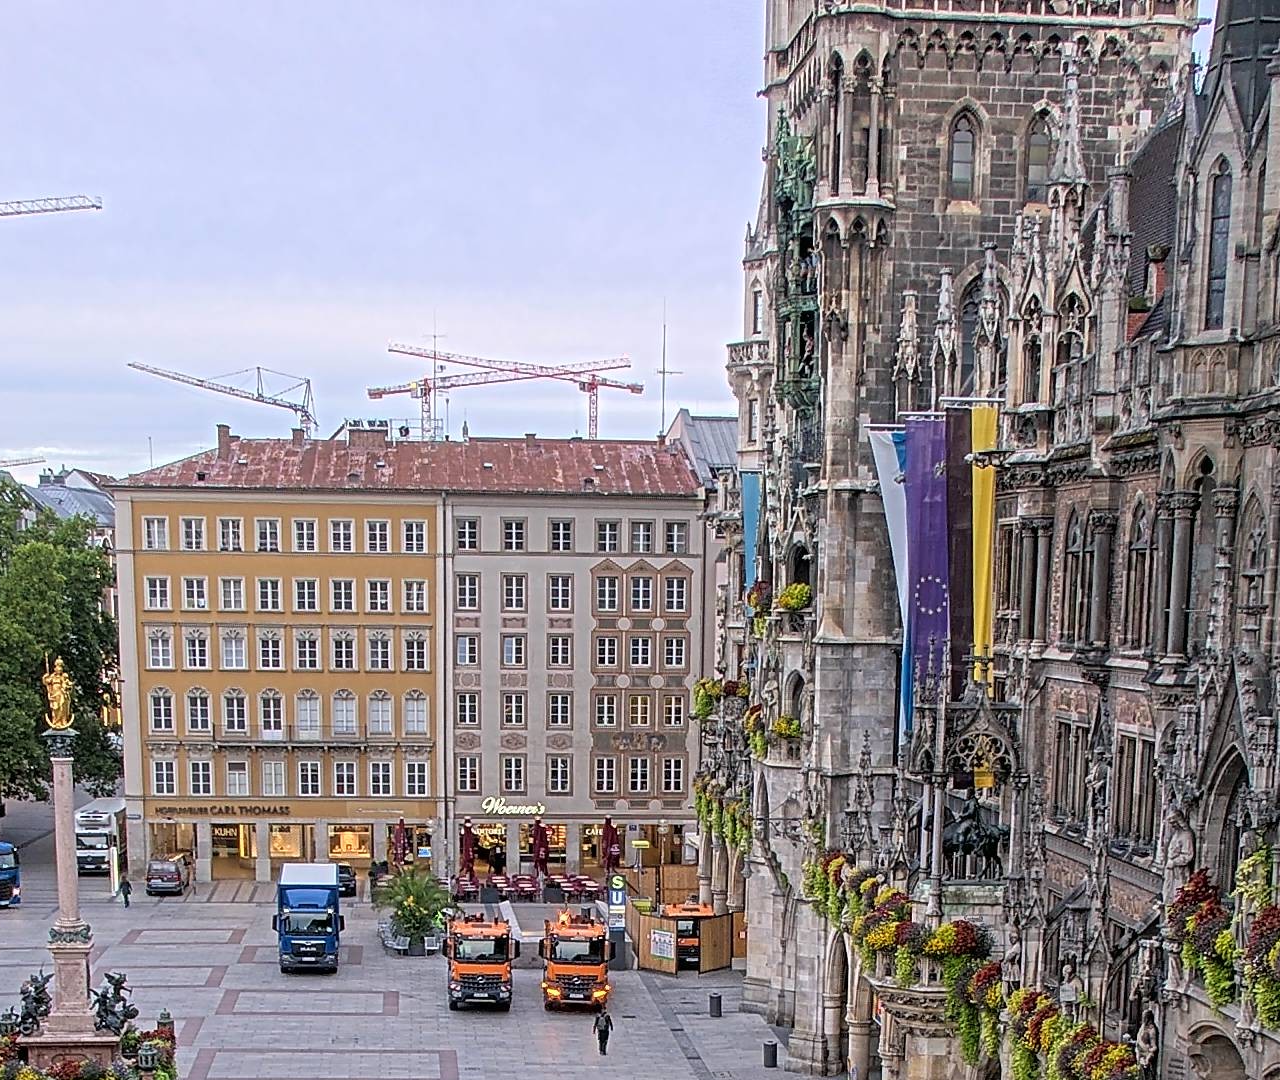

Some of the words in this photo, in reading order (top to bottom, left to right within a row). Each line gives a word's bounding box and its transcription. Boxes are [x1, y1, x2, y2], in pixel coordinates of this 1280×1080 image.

[210, 805, 236, 815] CARL
[238, 805, 291, 816] THOMASS
[214, 827, 238, 837] KUHN
[611, 875, 625, 889] S
[612, 891, 623, 904] U
